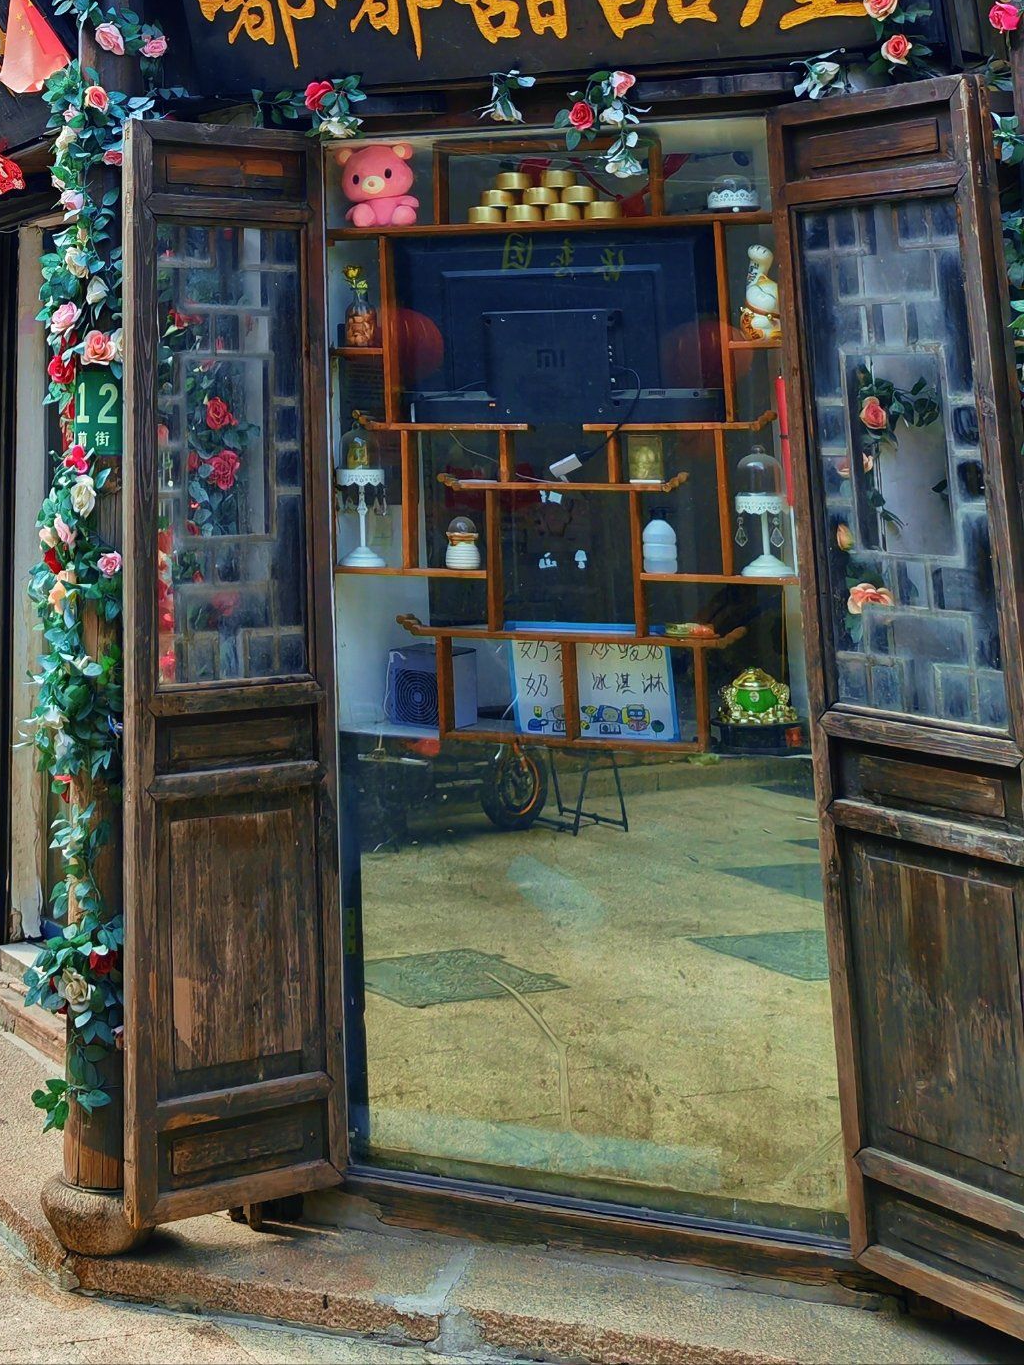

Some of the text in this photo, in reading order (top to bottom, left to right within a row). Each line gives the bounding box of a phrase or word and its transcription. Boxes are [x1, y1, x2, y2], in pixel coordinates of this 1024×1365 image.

[76, 381, 119, 424] 12
[77, 430, 110, 447] 前街
[591, 672, 669, 696] 冰淇淋
